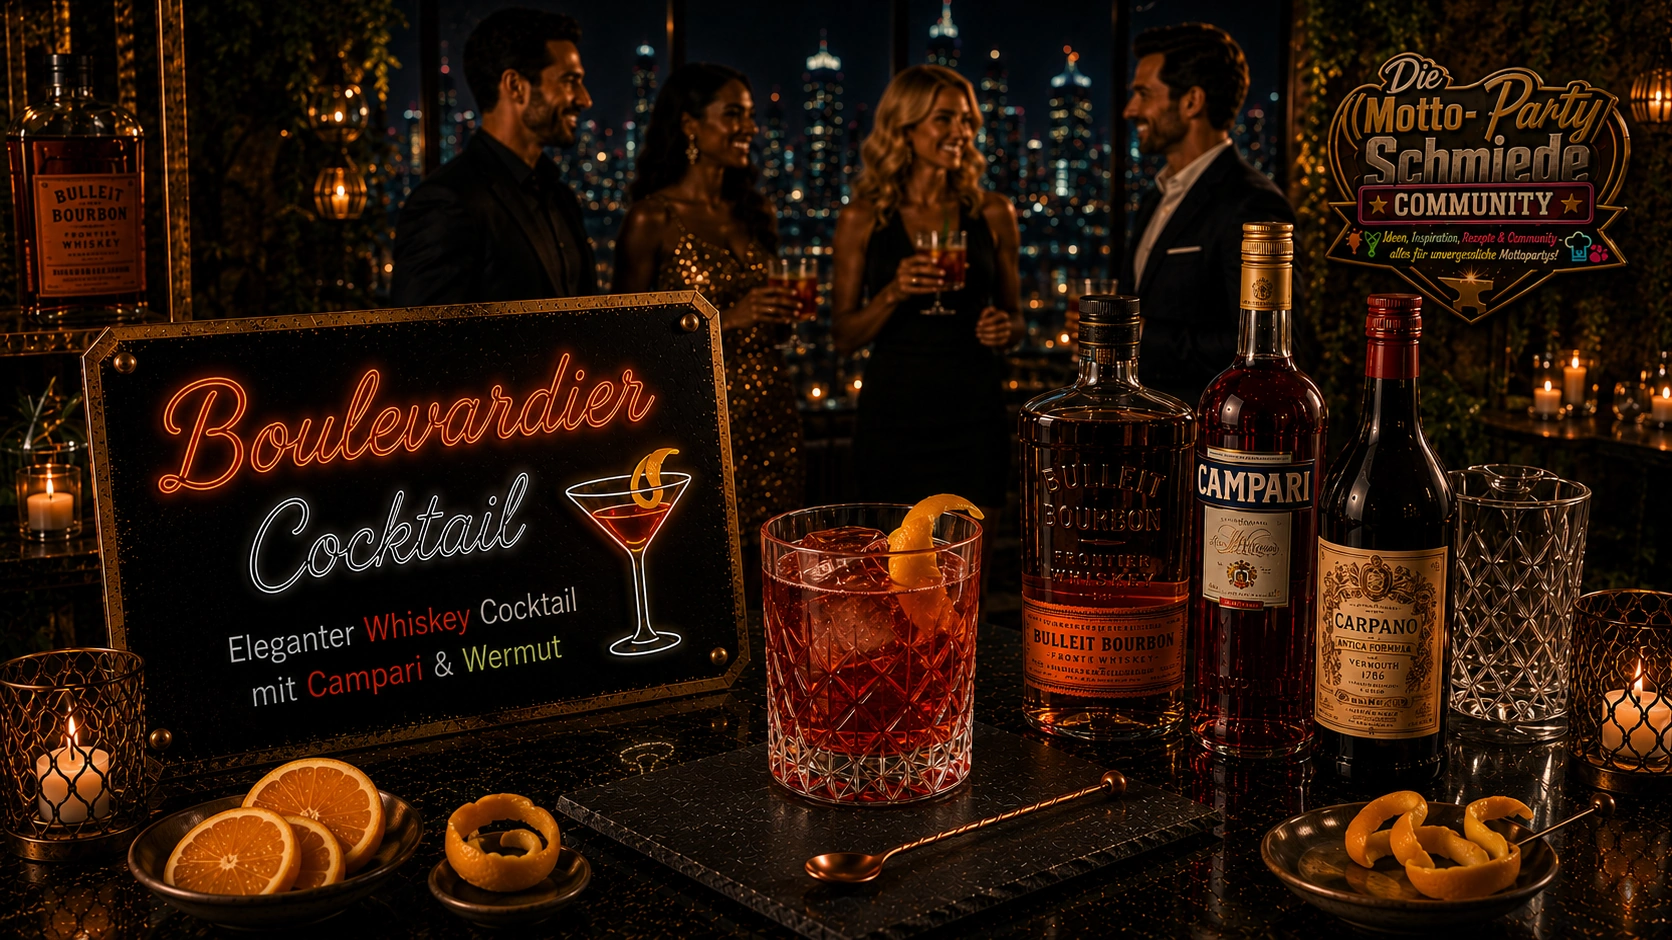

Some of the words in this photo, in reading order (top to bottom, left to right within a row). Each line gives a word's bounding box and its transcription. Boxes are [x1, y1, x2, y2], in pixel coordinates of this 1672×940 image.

[54, 185, 124, 204] BULLEIT
[52, 206, 127, 223] BOURBON
[62, 239, 120, 249] WHISKEY
[158, 353, 656, 494] Boulevardier
[1042, 463, 1167, 498] BULLEIT
[1198, 463, 1310, 503] CAMPARI
[1043, 503, 1162, 532] BOURBON
[250, 472, 530, 595] Cocktail
[1054, 550, 1151, 568] FRONTIER
[1050, 568, 1155, 588] WHISKEY
[228, 622, 355, 666] Eleganter
[363, 607, 471, 646] Whiskey
[480, 587, 578, 625] Cocktail
[1335, 612, 1418, 635] CARPANO
[1033, 628, 1095, 651] BULLEIT
[1101, 632, 1175, 652] BOURBON
[1337, 638, 1367, 652] ANTICA
[252, 676, 297, 707] mit
[308, 655, 423, 699] Campari
[434, 652, 454, 678] &
[462, 635, 562, 673] Wermut
[1361, 671, 1385, 681] 1786
